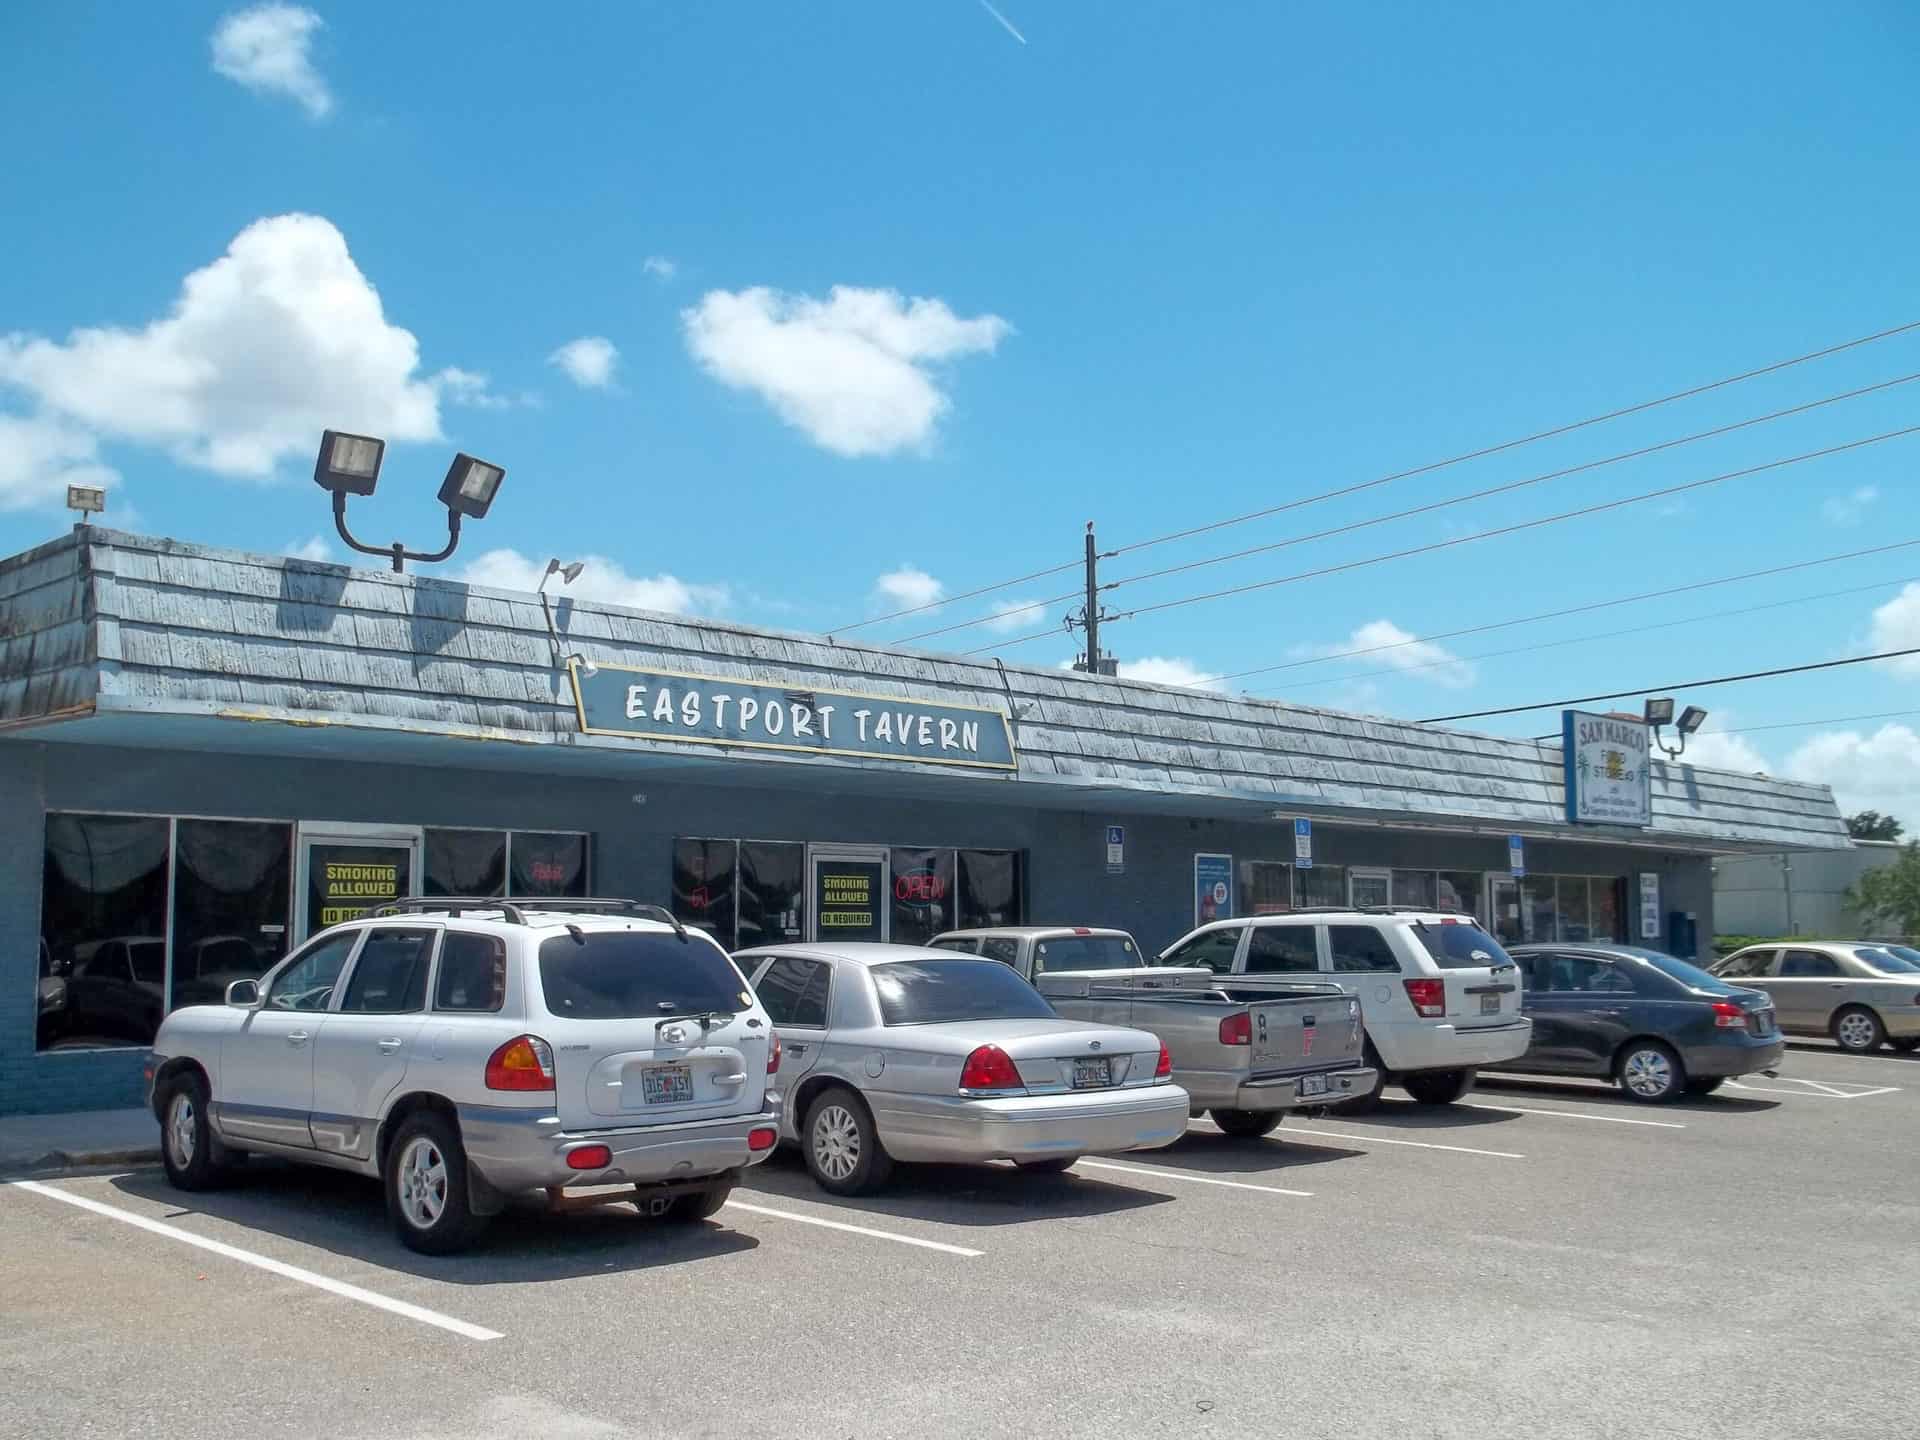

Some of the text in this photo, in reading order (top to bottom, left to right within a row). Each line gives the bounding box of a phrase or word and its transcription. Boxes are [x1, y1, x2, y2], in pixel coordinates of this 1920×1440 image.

[625, 685, 979, 752] EASTPORT TAVERN
[1579, 720, 1645, 753] SAN MARCO
[327, 867, 396, 880] SMOKING
[328, 882, 396, 895] ALLOWED
[823, 878, 870, 889] SMOKING
[895, 876, 945, 900] OPEN
[824, 891, 869, 902] ALLOWED
[325, 909, 338, 922] ID
